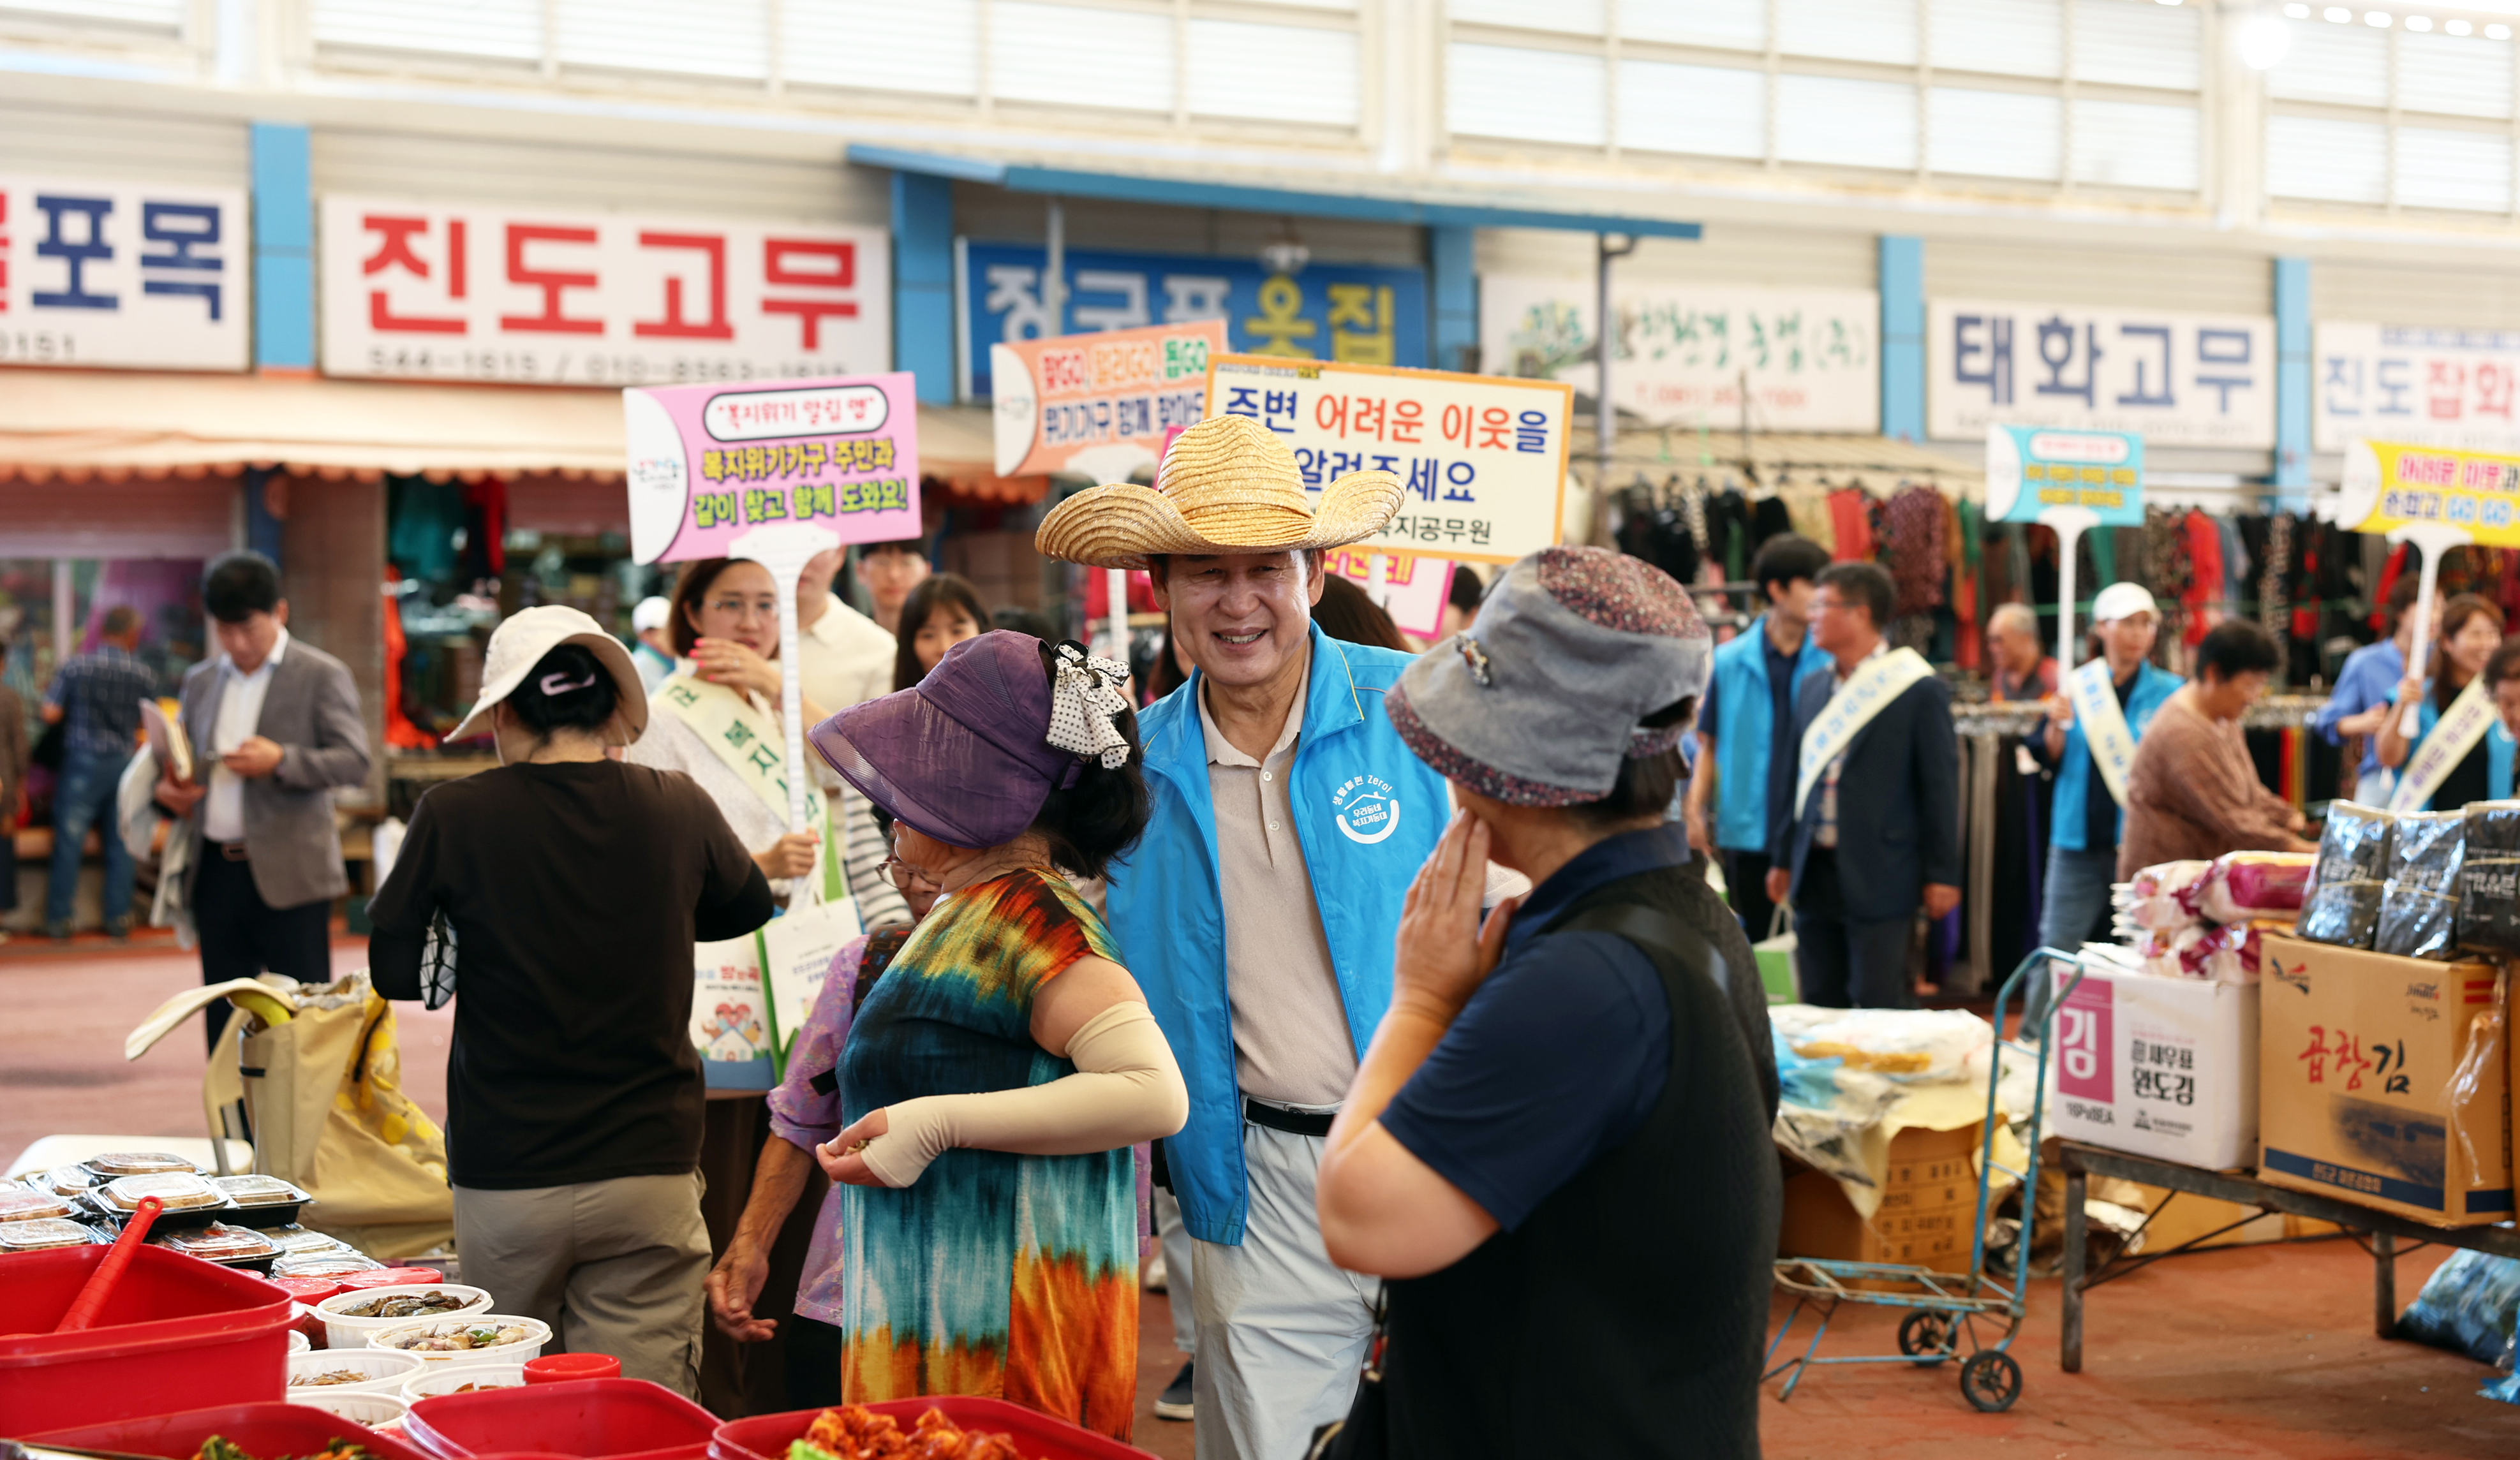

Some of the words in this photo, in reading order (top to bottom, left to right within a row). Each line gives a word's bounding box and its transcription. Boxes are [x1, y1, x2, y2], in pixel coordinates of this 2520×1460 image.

[362, 212, 859, 353] 진도고무
[1953, 314, 2254, 415] 태화고무
[1225, 387, 1298, 434] 주변
[1314, 393, 1425, 445] 어려운
[1441, 402, 1549, 454] 이웃을
[701, 441, 828, 484] 복지위기가구
[833, 438, 896, 474] 주민과
[693, 490, 738, 529] 같이
[743, 487, 787, 524] 찾고
[792, 482, 836, 520] 함께
[840, 478, 908, 515] 도와요!
[1367, 774, 1393, 793] Zero!
[2061, 1007, 2098, 1080] 김
[2298, 1024, 2410, 1094] 곱창김
[2132, 1065, 2194, 1106] 완도김
